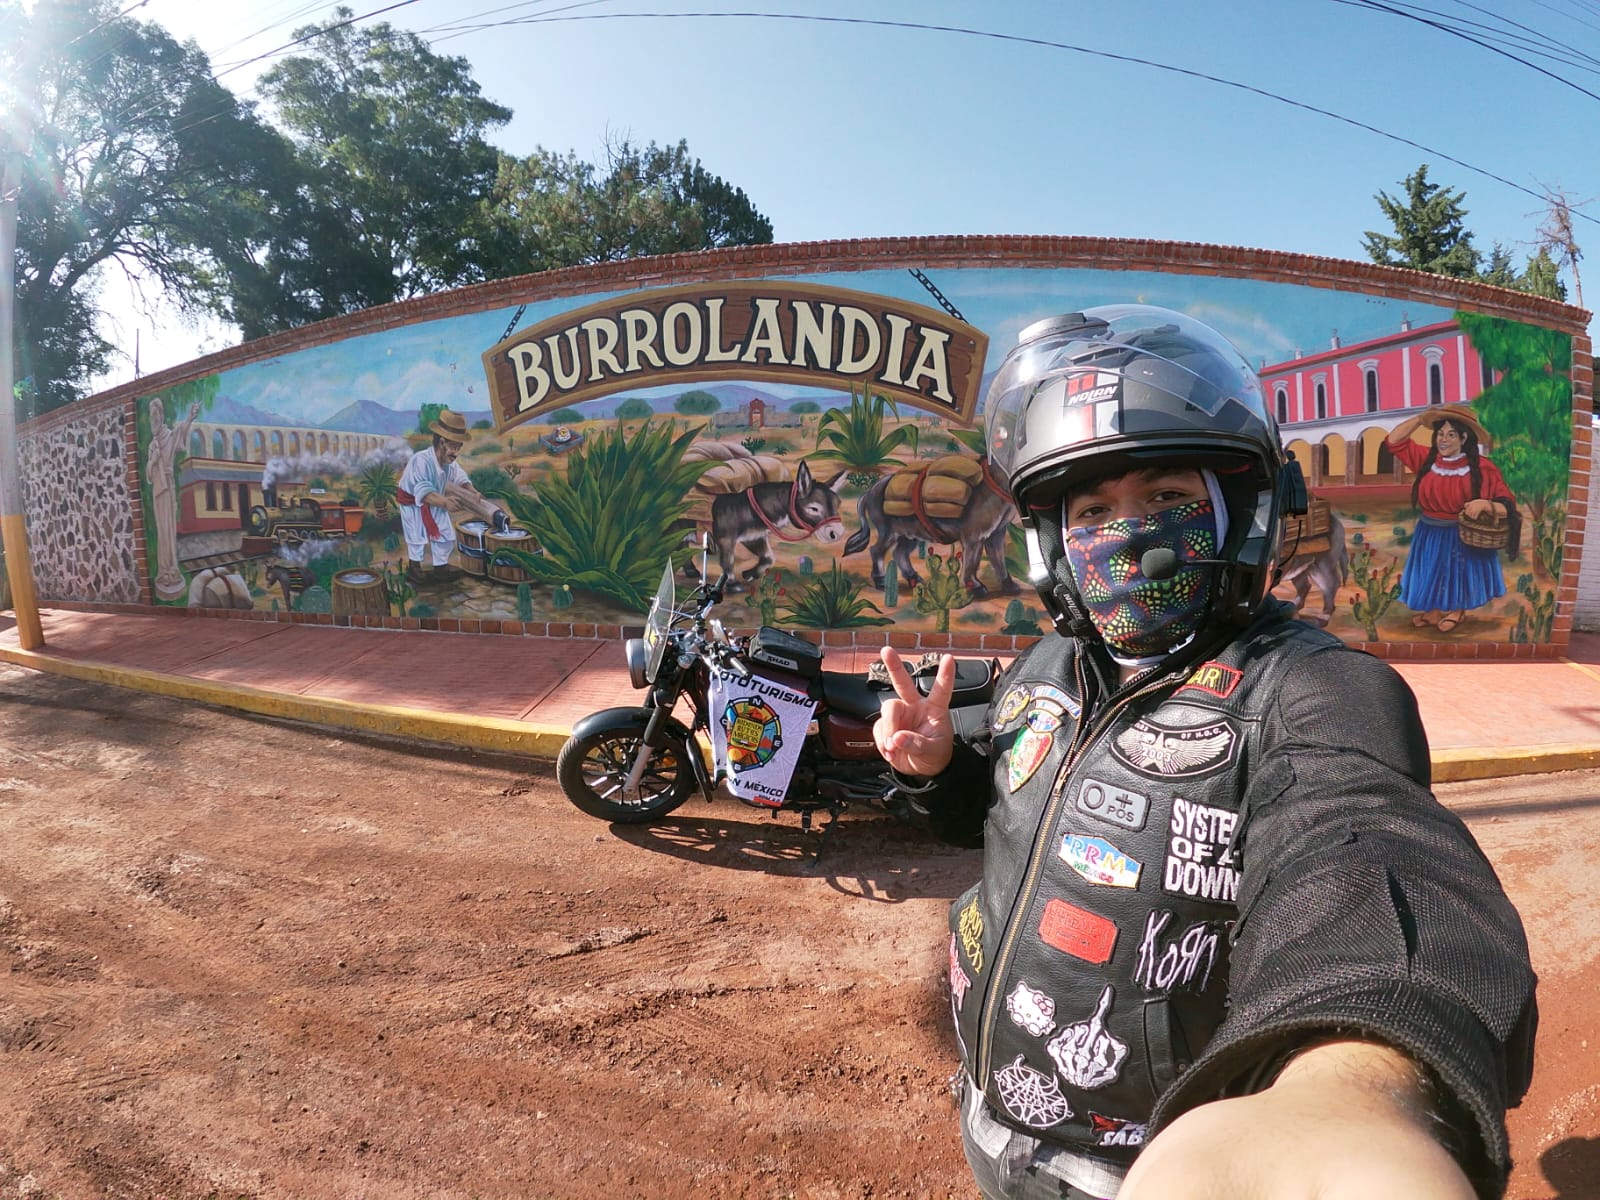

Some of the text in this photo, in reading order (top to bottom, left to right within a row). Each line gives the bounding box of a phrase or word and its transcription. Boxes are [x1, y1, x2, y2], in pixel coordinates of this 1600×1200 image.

[507, 297, 954, 412] BURROLANDIA
[1068, 386, 1118, 405] NOLAN
[767, 655, 790, 666] SHAD
[1140, 746, 1172, 762] 2003
[744, 780, 784, 797] MÉXICO
[1106, 805, 1135, 823] POS
[1069, 837, 1126, 875] RRM
[1171, 836, 1213, 863] OF
[1165, 856, 1241, 902] DOWN
